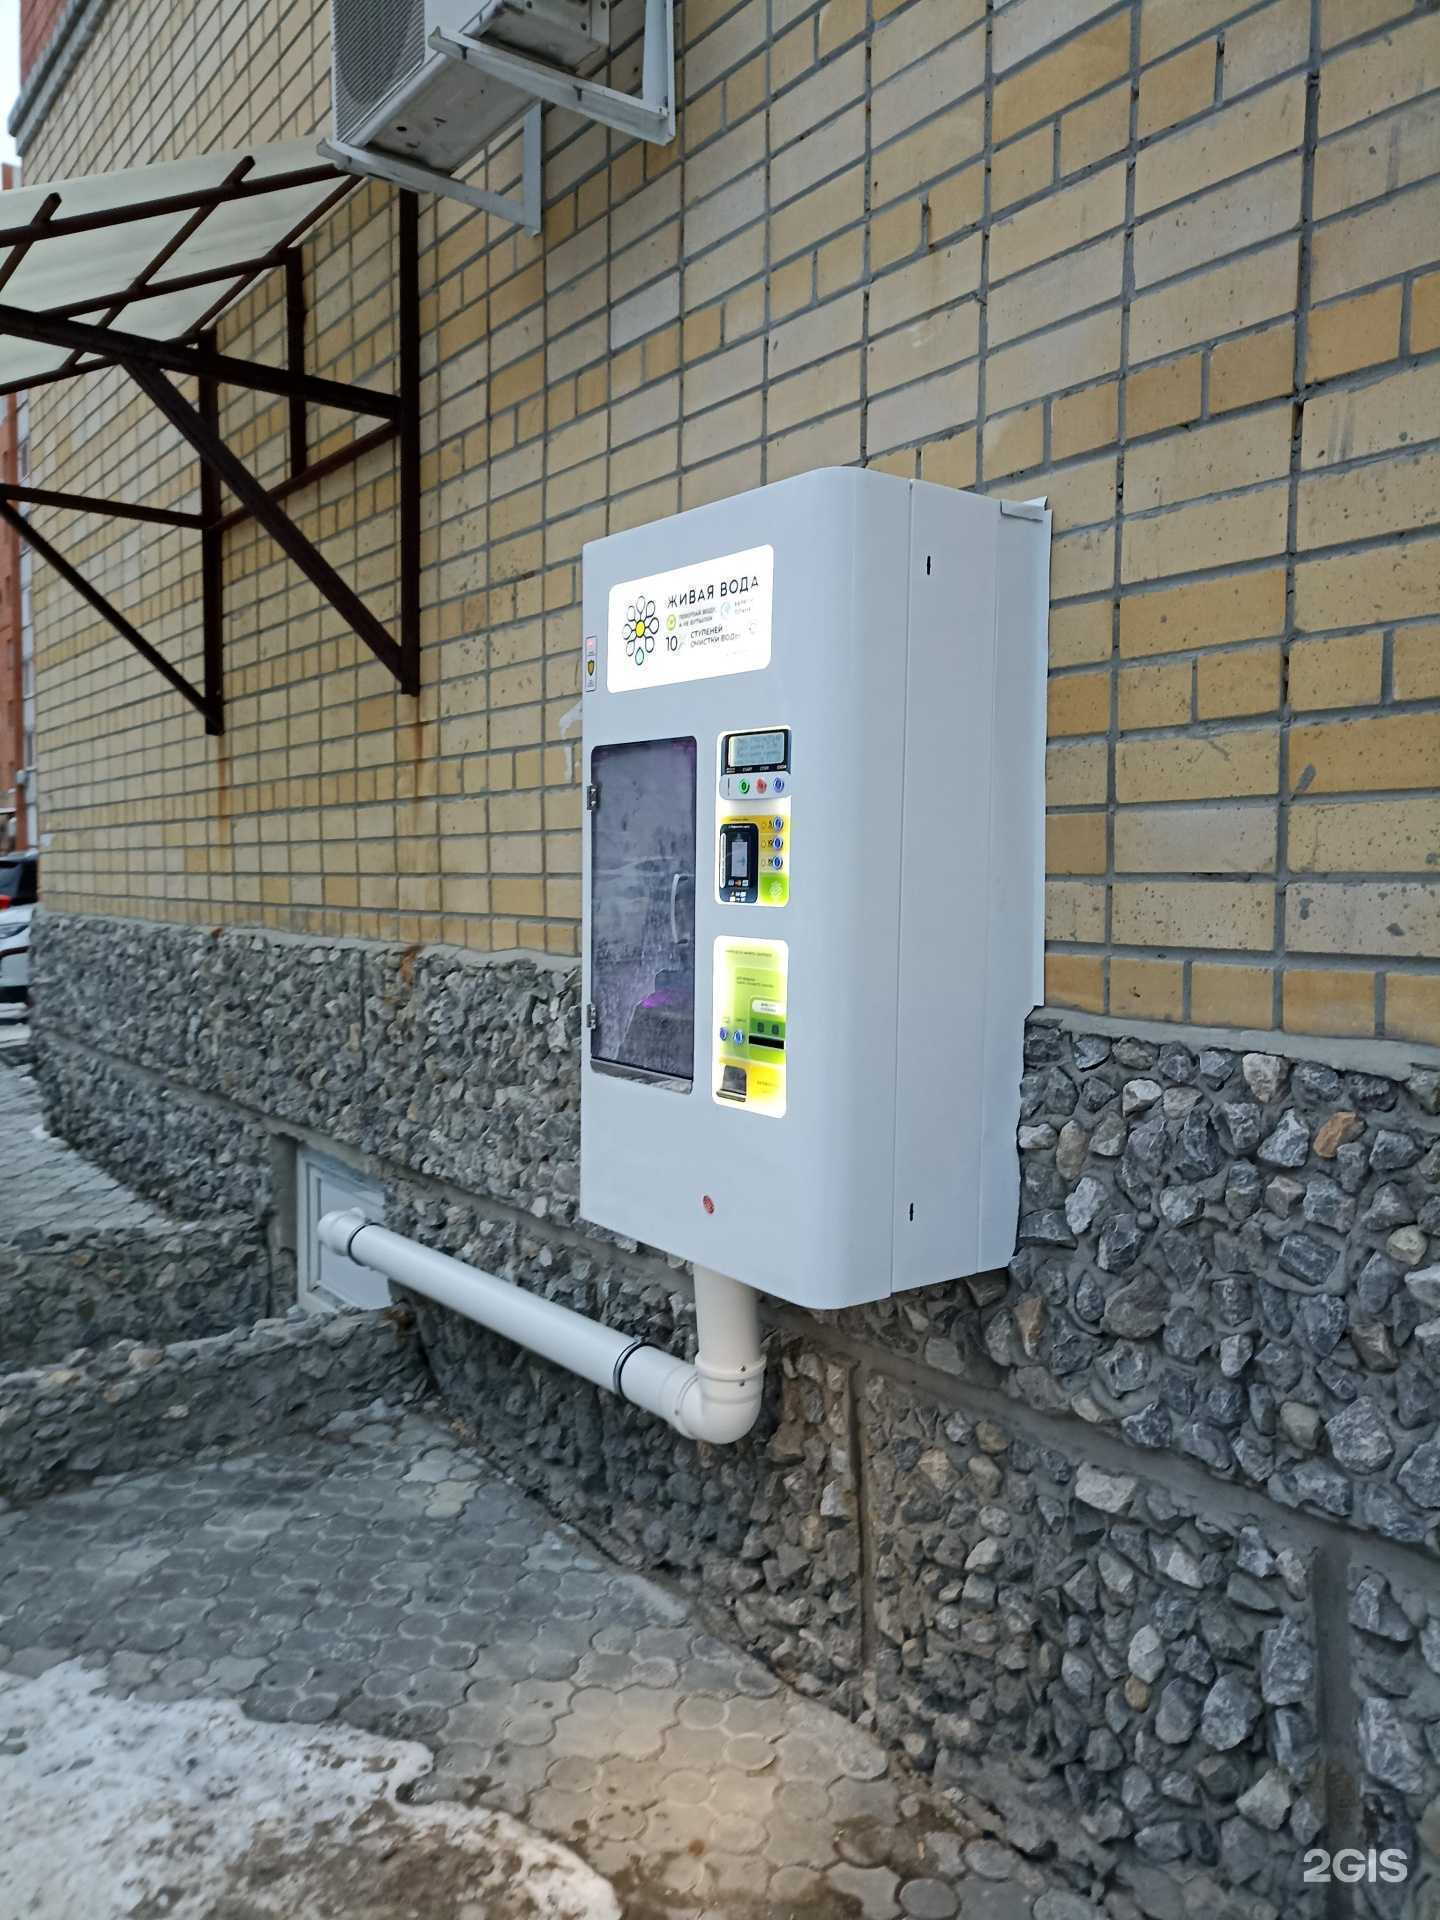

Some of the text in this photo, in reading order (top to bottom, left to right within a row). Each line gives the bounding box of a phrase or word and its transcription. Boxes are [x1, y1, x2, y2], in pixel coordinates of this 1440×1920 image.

[667, 576, 759, 608] ЖИВАЯ ВОДА
[665, 635, 678, 652] 10
